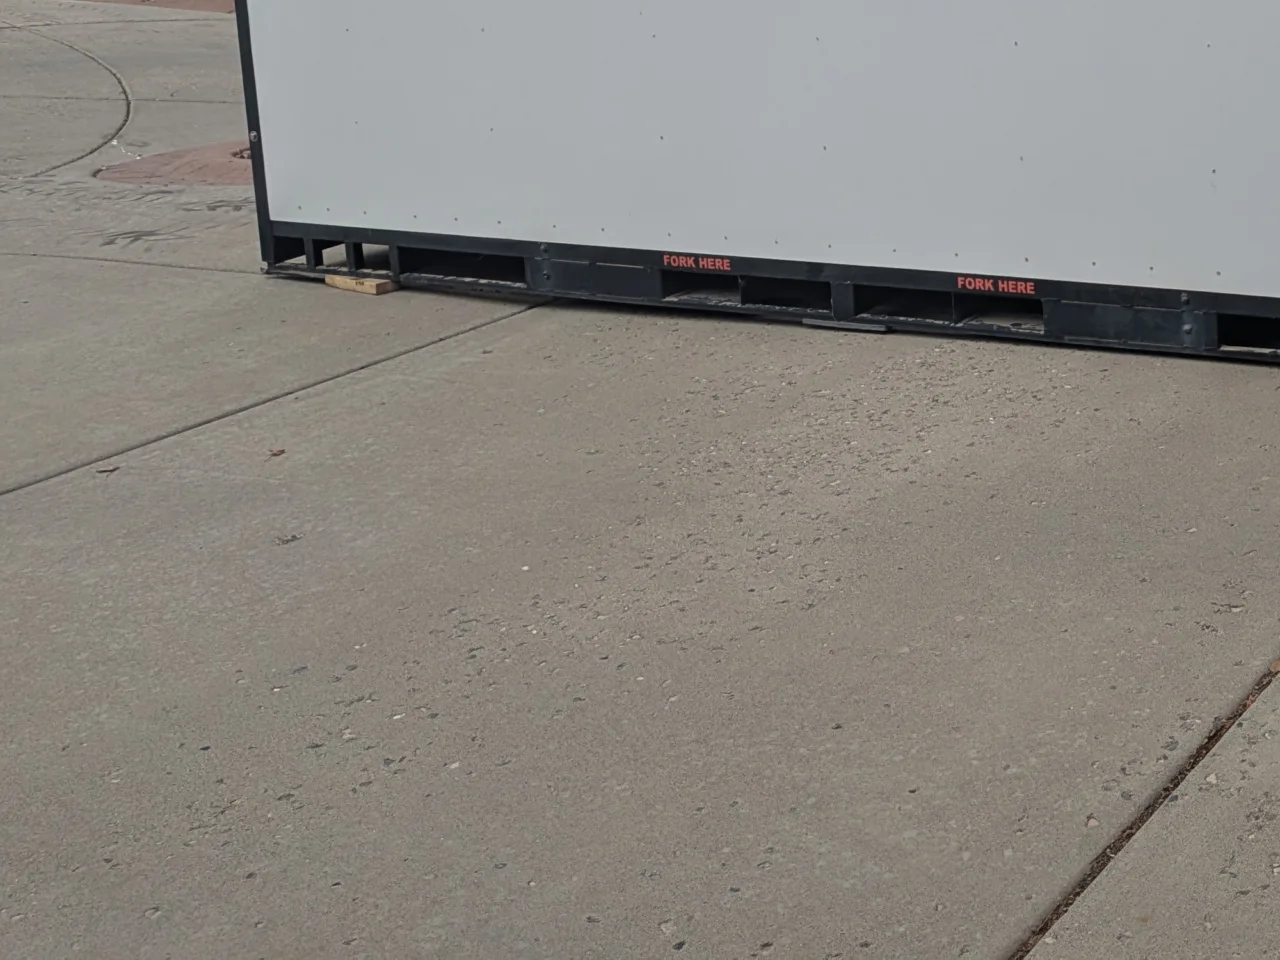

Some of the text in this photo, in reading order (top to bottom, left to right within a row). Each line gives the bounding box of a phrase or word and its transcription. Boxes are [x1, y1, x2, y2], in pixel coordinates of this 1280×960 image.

[663, 254, 731, 271] FORK HERE
[957, 276, 1035, 295] FORK HERE
